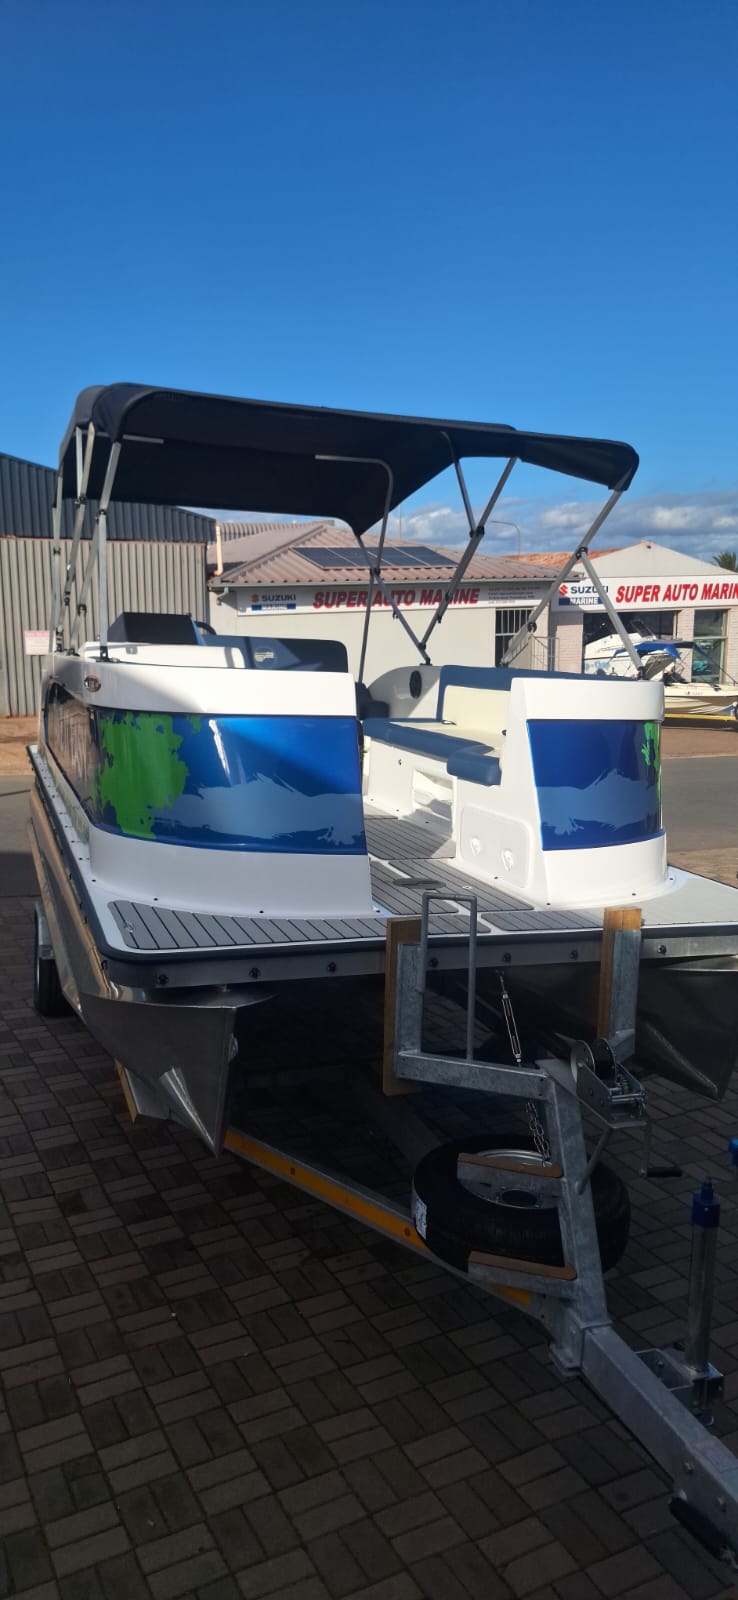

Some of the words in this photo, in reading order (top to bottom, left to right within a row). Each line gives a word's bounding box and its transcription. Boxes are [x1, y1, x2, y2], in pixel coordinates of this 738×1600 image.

[570, 585, 609, 594] SUZUI
[615, 584, 661, 603] SUPER
[662, 583, 699, 602] AUTO
[261, 594, 296, 602] SUZUKI
[312, 591, 369, 609] SUPER
[419, 588, 480, 606] MAINE
